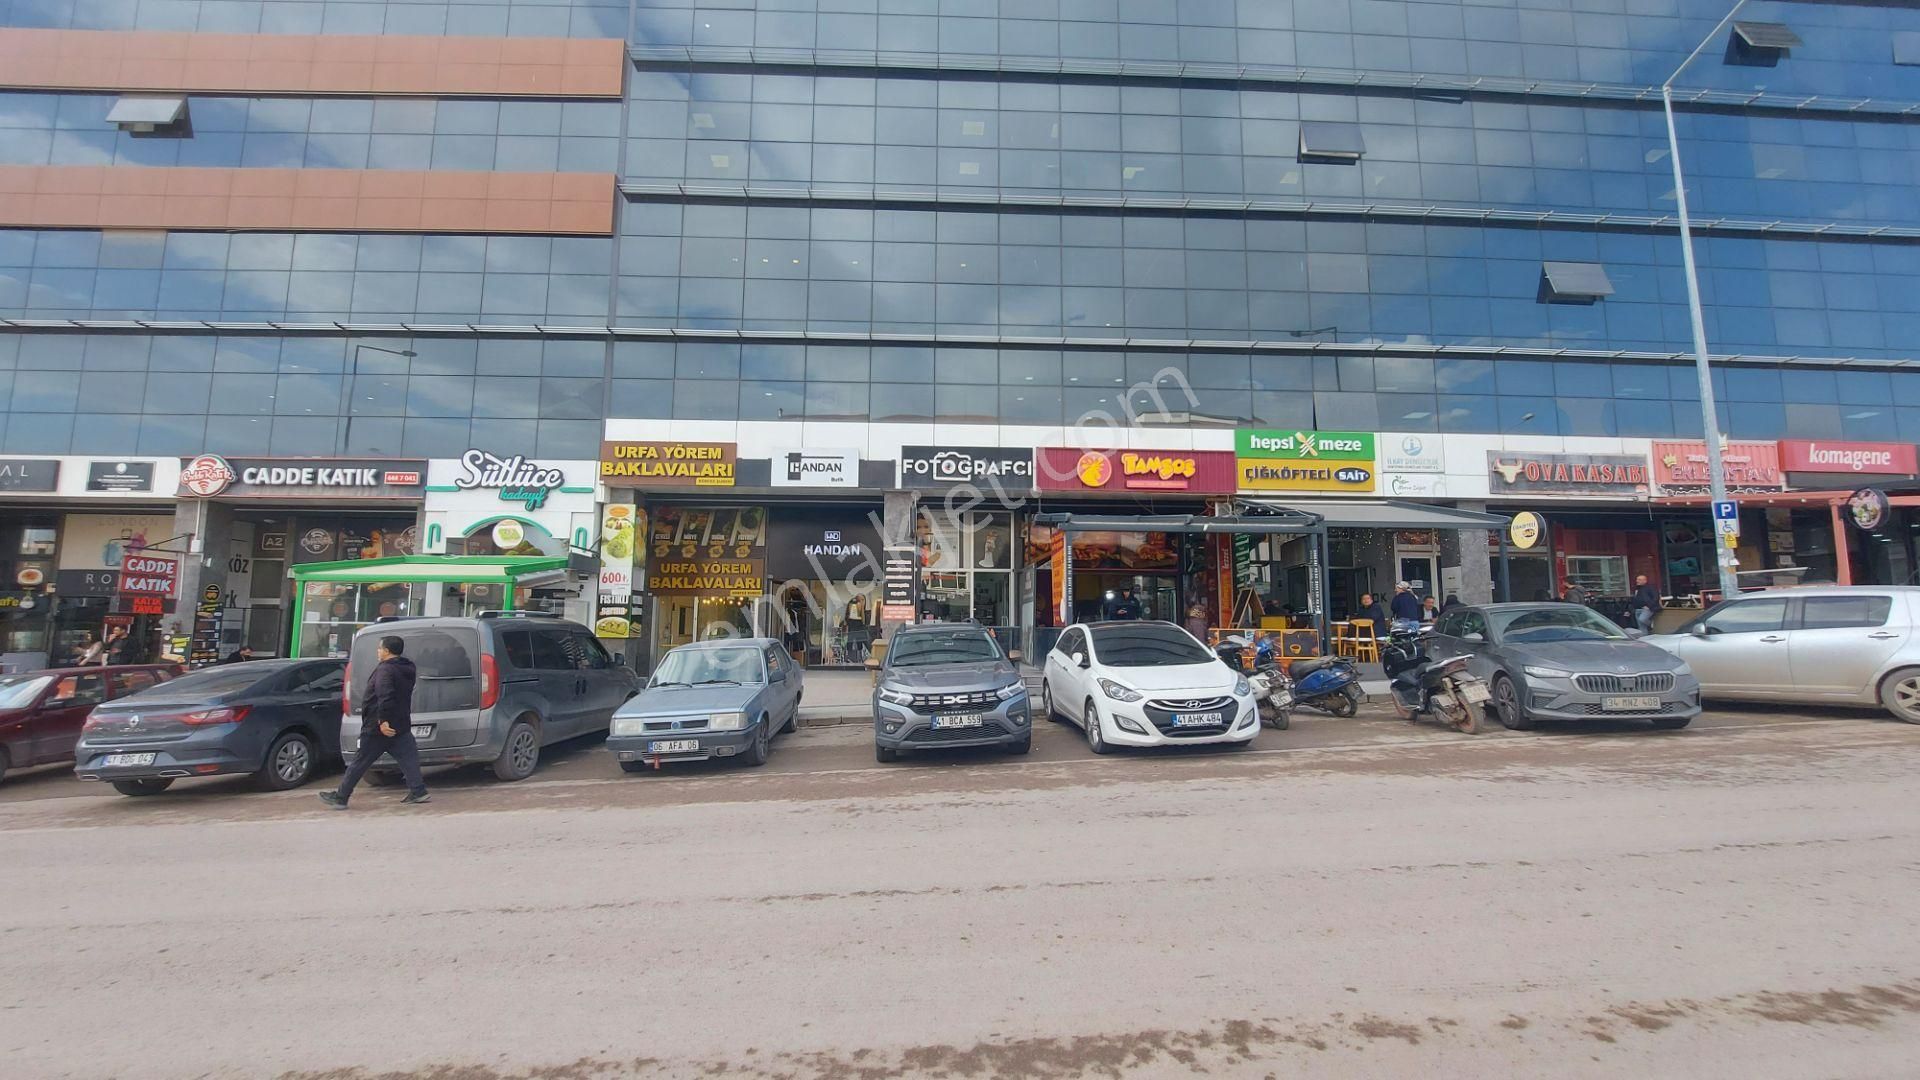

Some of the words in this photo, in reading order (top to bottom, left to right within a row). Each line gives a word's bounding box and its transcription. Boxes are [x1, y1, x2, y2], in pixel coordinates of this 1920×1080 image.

[1250, 435, 1294, 450] hepsi
[1319, 439, 1362, 451] meze
[614, 446, 658, 458] URFA
[663, 444, 722, 459] YÖREM
[1809, 443, 1891, 470] komagene
[456, 449, 561, 488] Sütlüce
[601, 462, 733, 477] BAKLAVALARI
[793, 463, 842, 472] HANDAN
[1245, 466, 1331, 482] ÇİĞKÖFTECİ
[1338, 470, 1366, 481] SAİT
[243, 467, 313, 485] CADDE
[316, 468, 378, 486] KATIK
[1720, 504, 1732, 516] P
[265, 537, 284, 546] A2
[804, 545, 860, 555] HANDAN
[127, 559, 174, 573] CADDE
[661, 563, 697, 573] URFA
[701, 561, 752, 574] YÖREM
[125, 578, 171, 592] KATIK
[649, 577, 760, 589] BAKLAVALARI
[936, 717, 945, 725] 41
[949, 716, 963, 724] BCA
[968, 715, 981, 723] 559
[1177, 715, 1185, 723] 41
[1188, 715, 1205, 723] AHK
